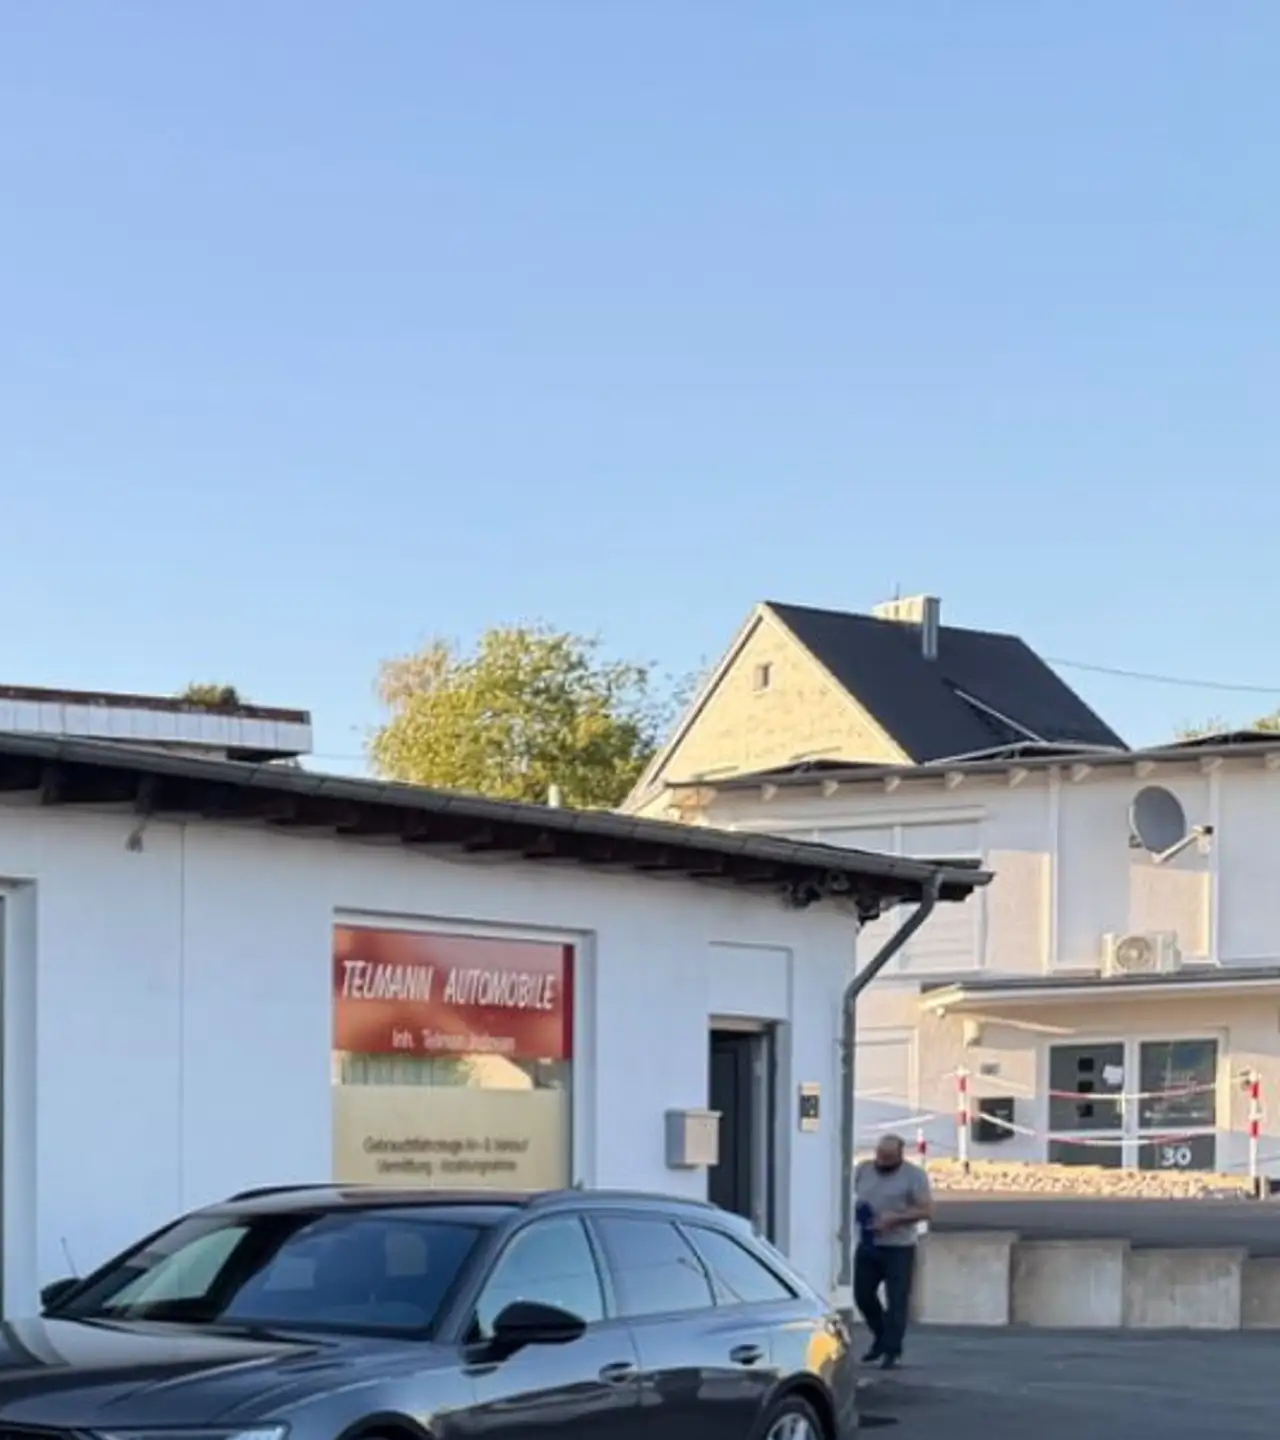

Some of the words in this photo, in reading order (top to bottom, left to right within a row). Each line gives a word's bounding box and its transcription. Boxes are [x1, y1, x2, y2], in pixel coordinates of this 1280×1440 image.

[341, 960, 434, 1002] TELMANN
[444, 967, 555, 1009] AUTOMOBILE
[1161, 1145, 1192, 1166] 30
